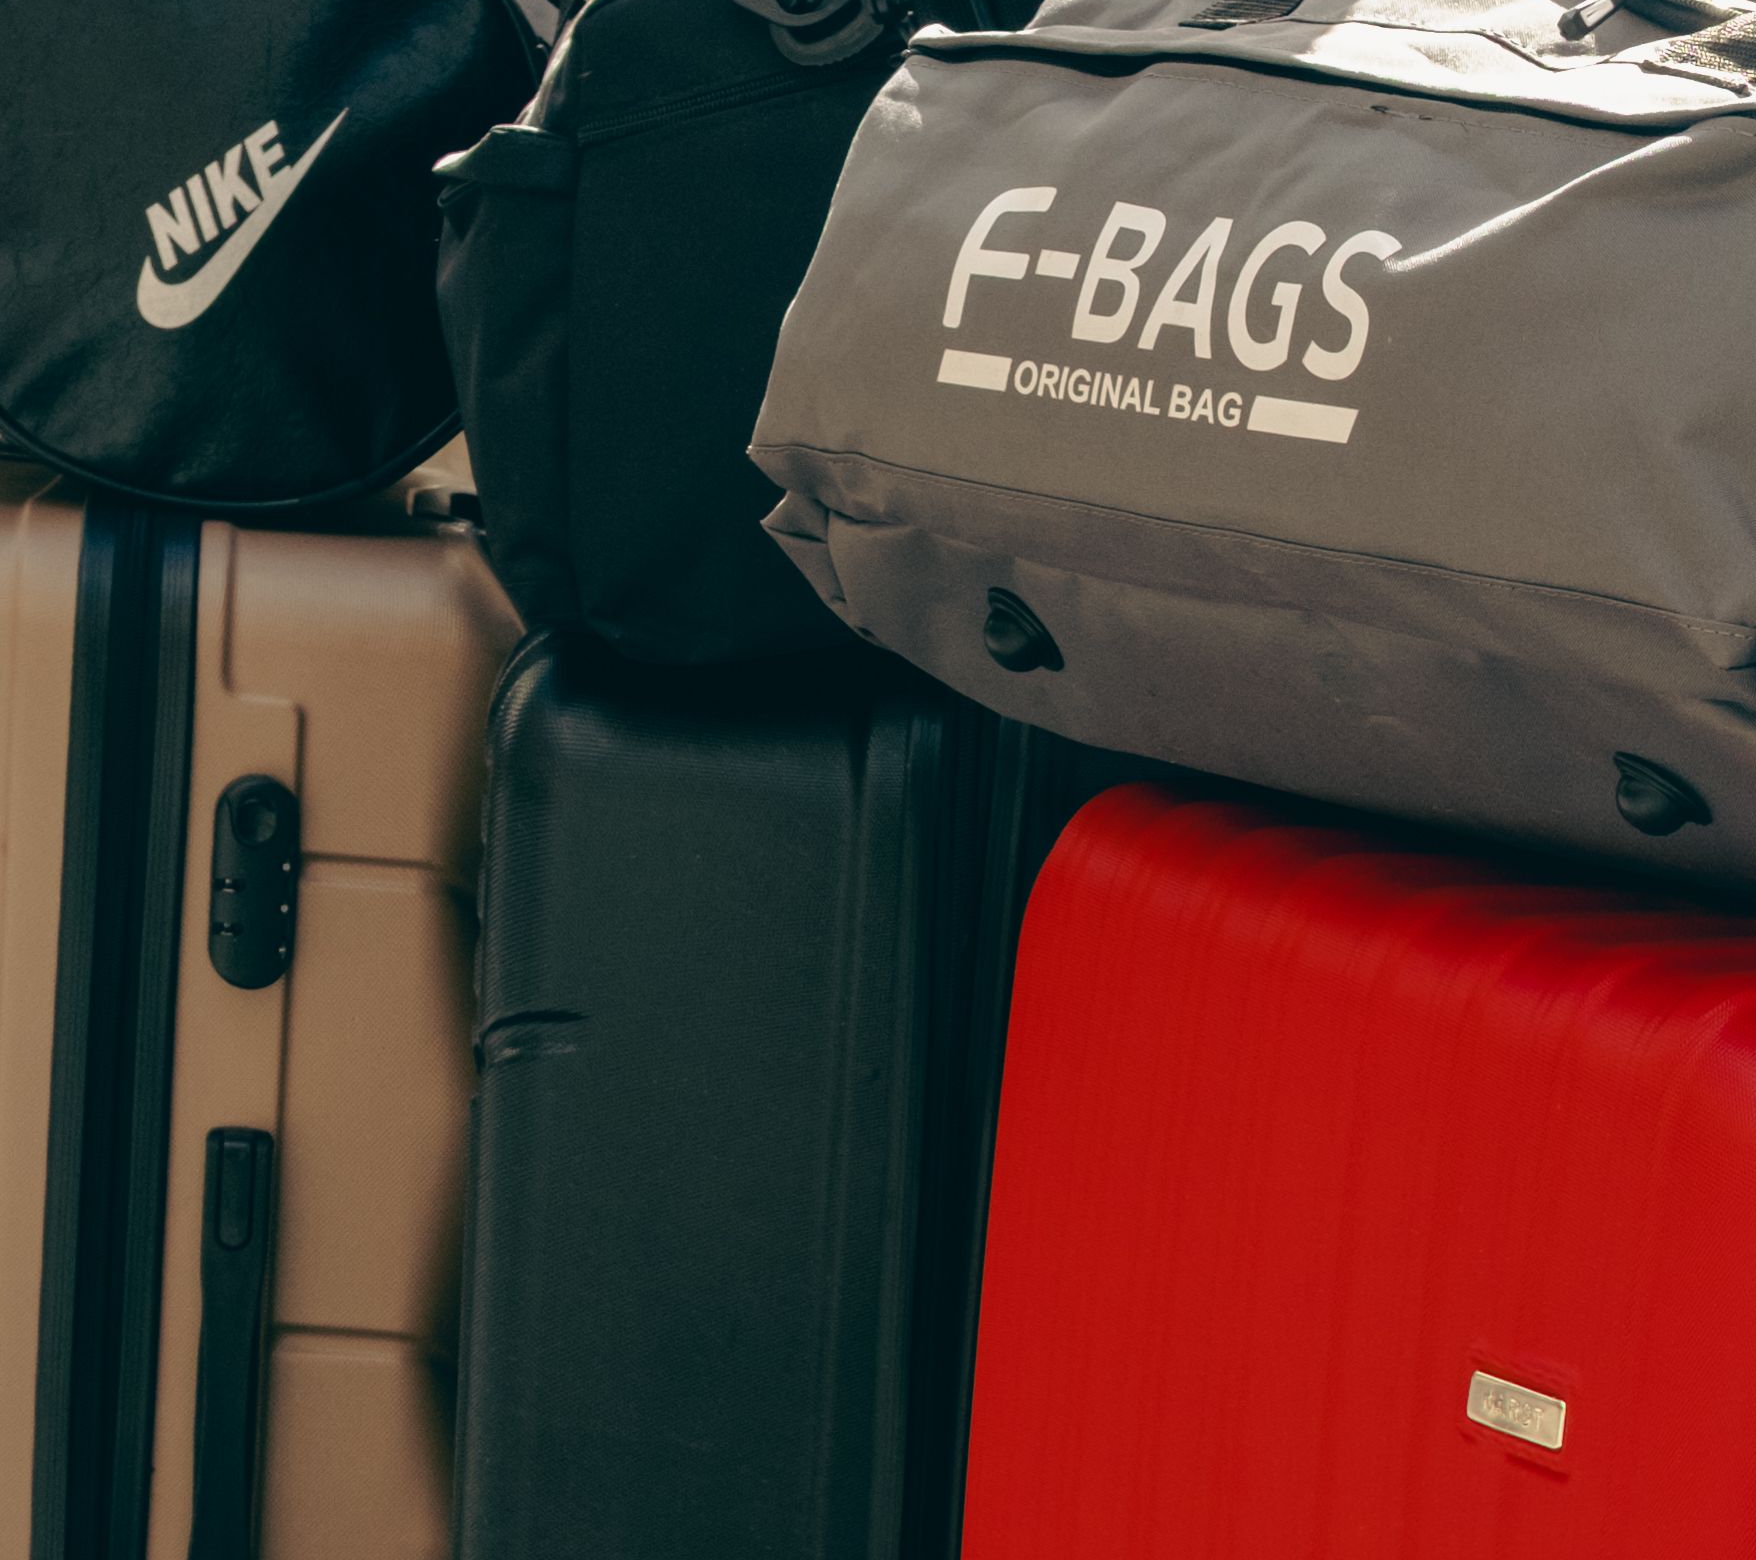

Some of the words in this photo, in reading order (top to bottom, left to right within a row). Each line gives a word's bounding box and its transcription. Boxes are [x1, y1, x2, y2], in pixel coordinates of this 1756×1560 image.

[145, 119, 292, 272] NIKE
[942, 185, 1403, 381] F-BAGS
[1013, 360, 1161, 416] ORIGINAL
[1167, 384, 1243, 428] BAG
